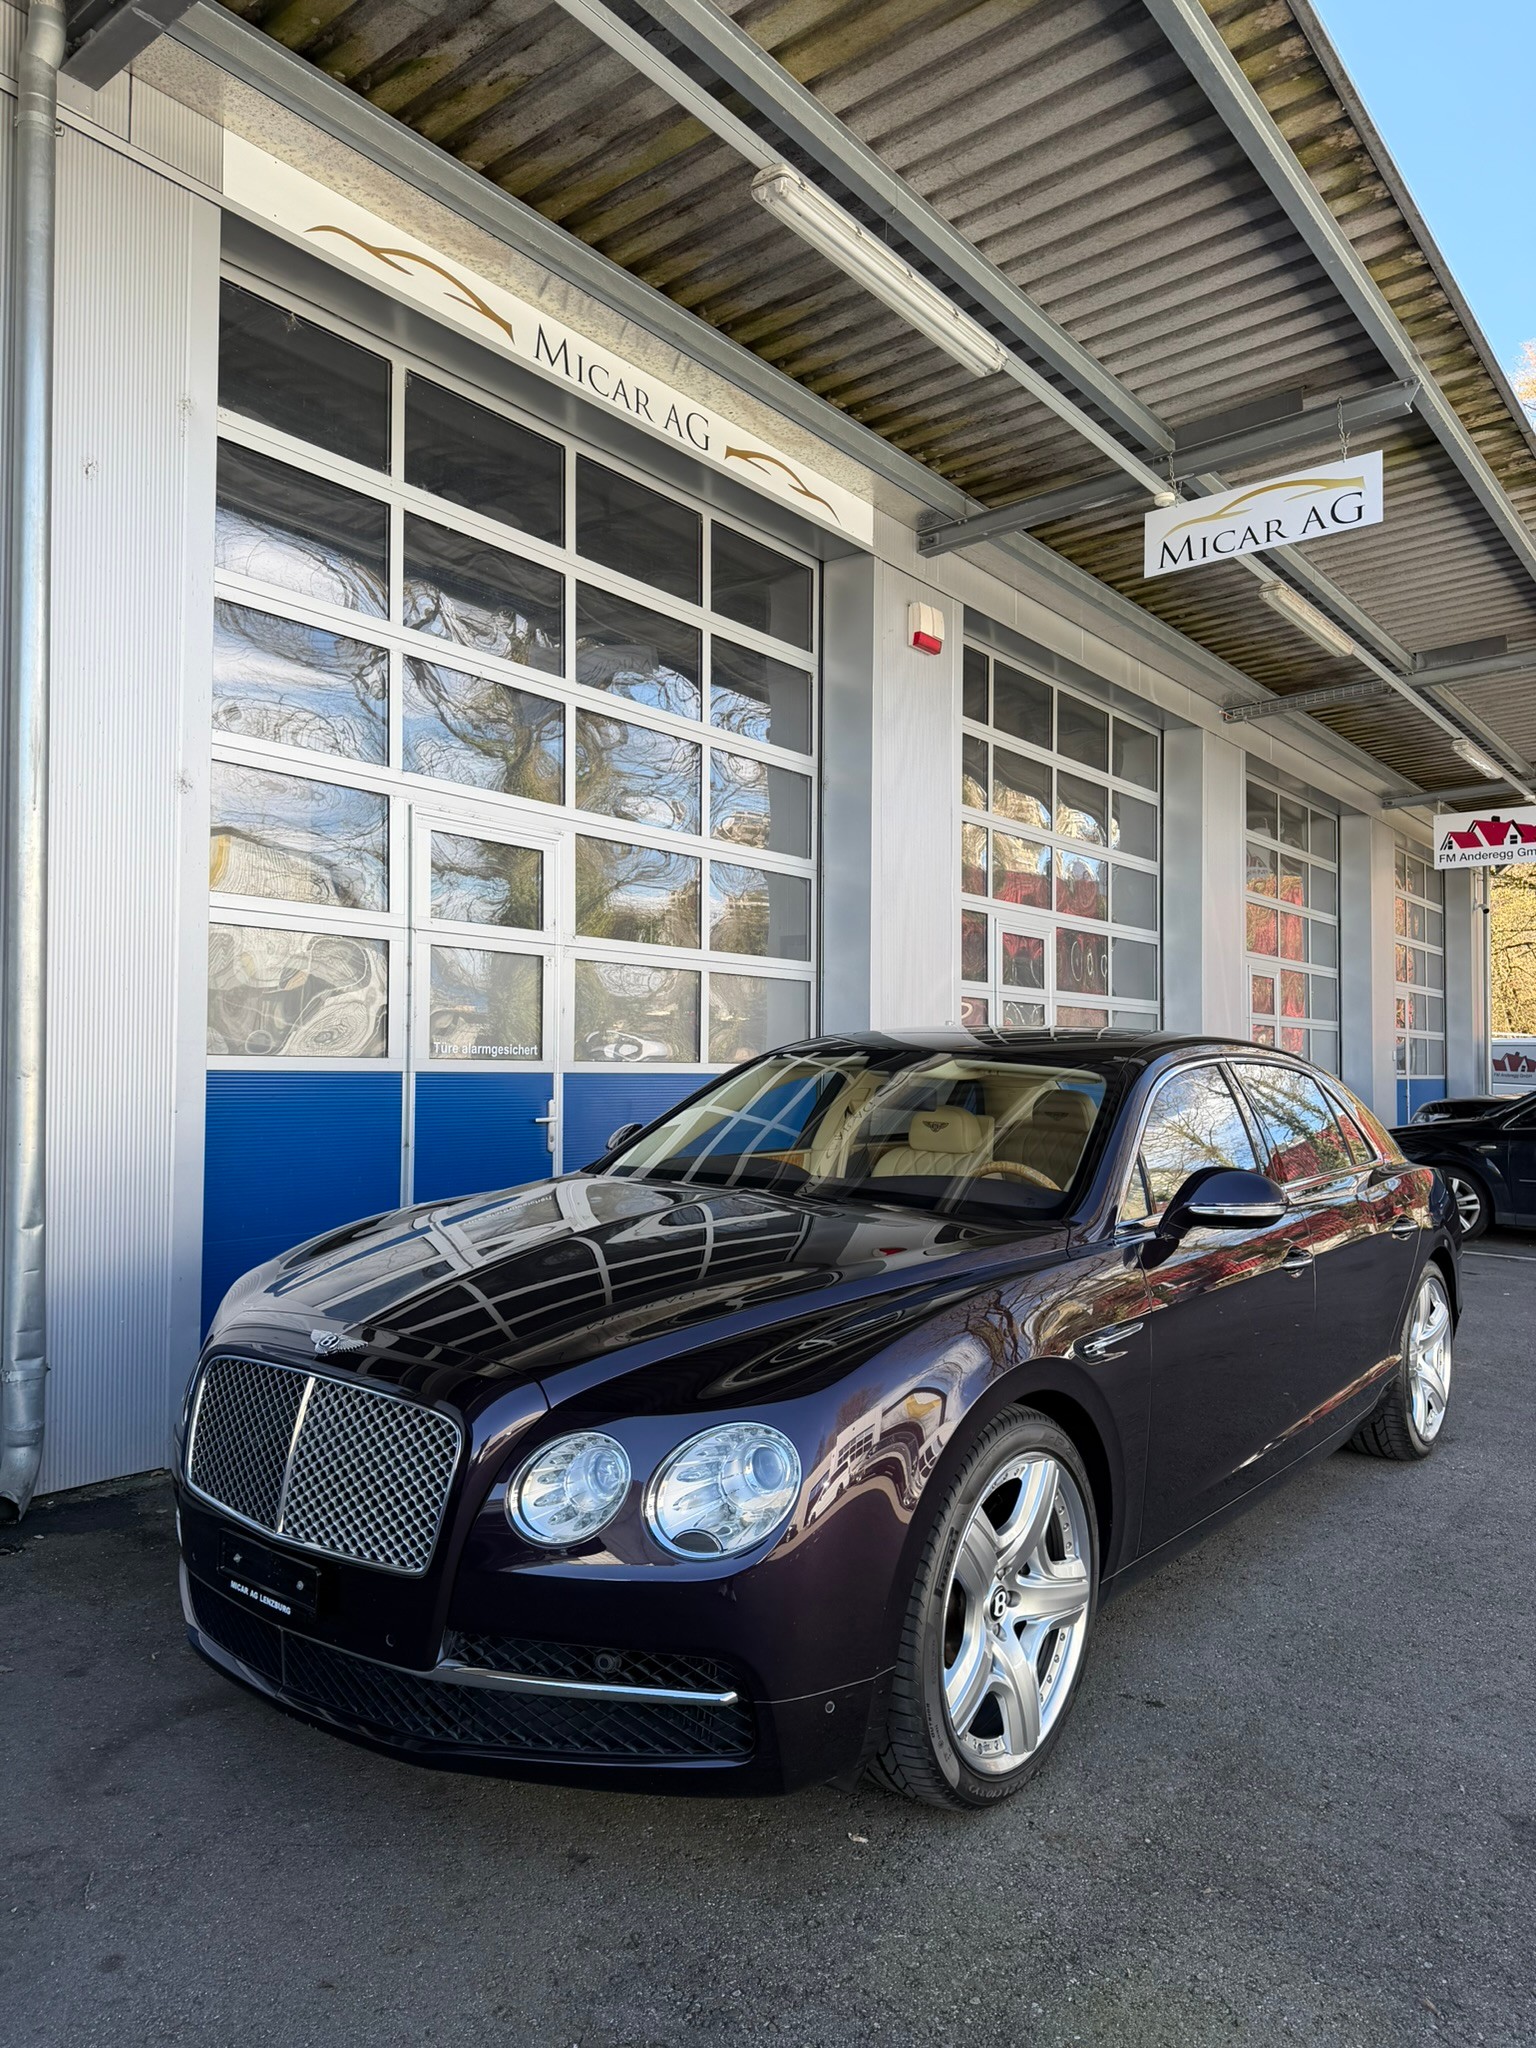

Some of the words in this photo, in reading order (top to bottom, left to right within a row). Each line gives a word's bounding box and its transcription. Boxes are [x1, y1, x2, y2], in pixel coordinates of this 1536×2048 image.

[533, 323, 656, 423] MICAR
[663, 403, 710, 451] AG
[1158, 518, 1289, 570] MICAR
[1300, 491, 1366, 536] AG
[1439, 853, 1456, 863] FM
[1460, 851, 1513, 860] Anderegg
[433, 1041, 459, 1054] Türe
[462, 1043, 538, 1057] alarmgesichert
[250, 1590, 259, 1600] AG
[260, 1594, 292, 1615] LENZBURG
